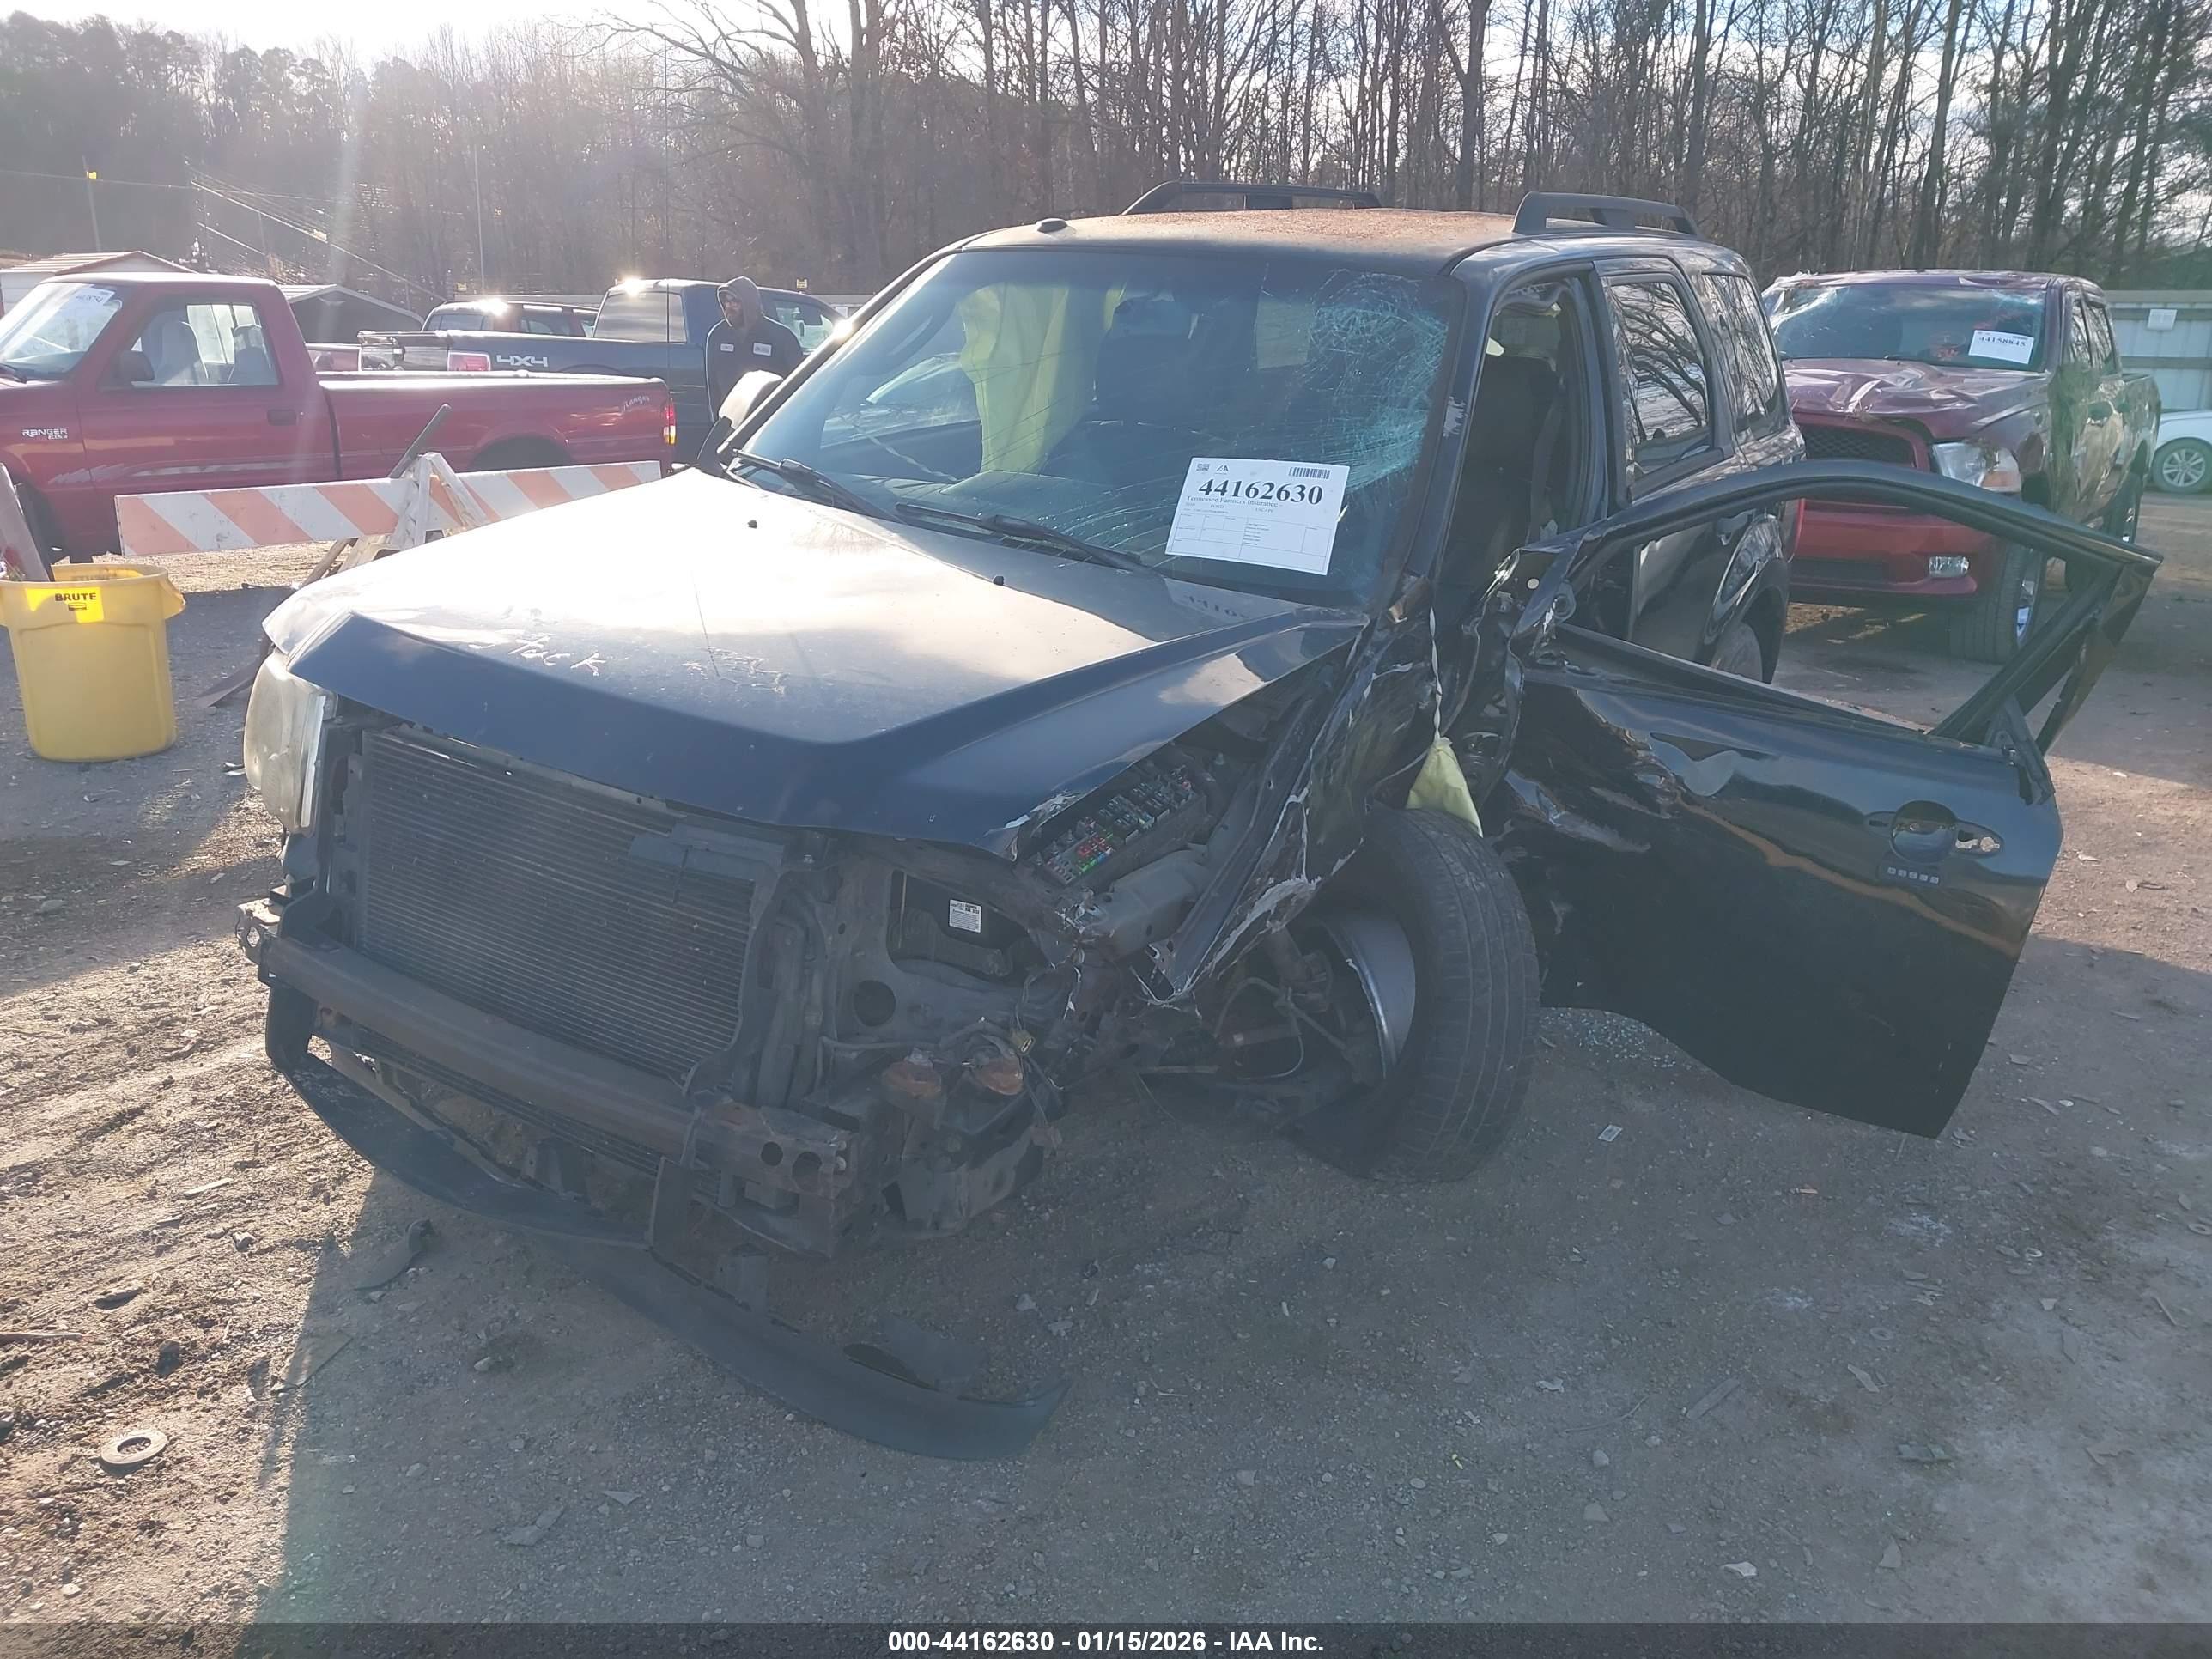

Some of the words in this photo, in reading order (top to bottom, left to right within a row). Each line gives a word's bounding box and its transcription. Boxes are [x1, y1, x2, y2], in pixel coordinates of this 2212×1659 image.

[22, 428, 68, 437] RANGER
[1198, 478, 1324, 505] 44162630
[1247, 499, 1279, 507] Insurance
[55, 592, 97, 602] BRUTE
